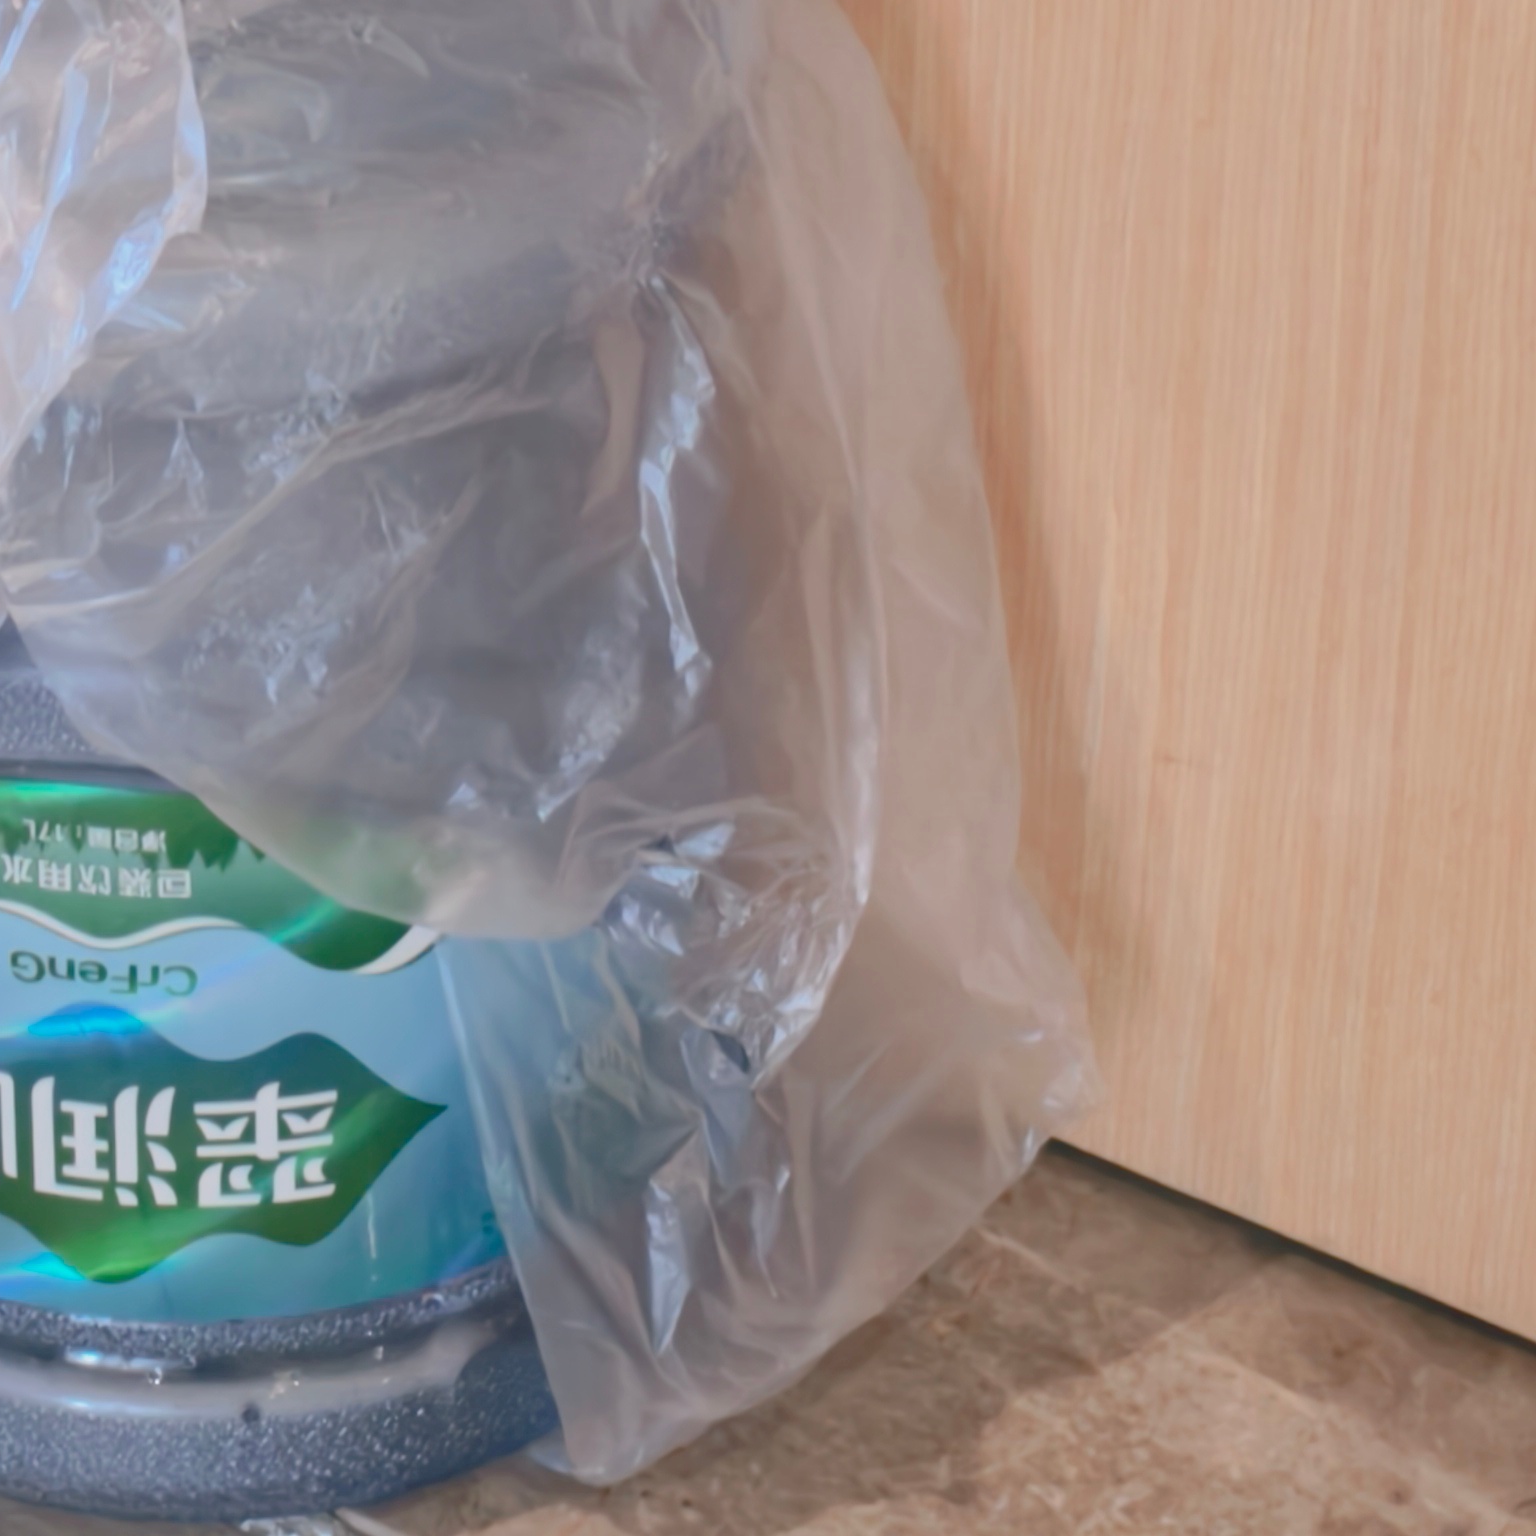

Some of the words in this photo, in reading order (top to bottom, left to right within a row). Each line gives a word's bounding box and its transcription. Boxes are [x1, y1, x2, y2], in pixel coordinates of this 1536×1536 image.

[3, 850, 194, 899] 包装饮用水
[8, 948, 199, 997] CrFenG
